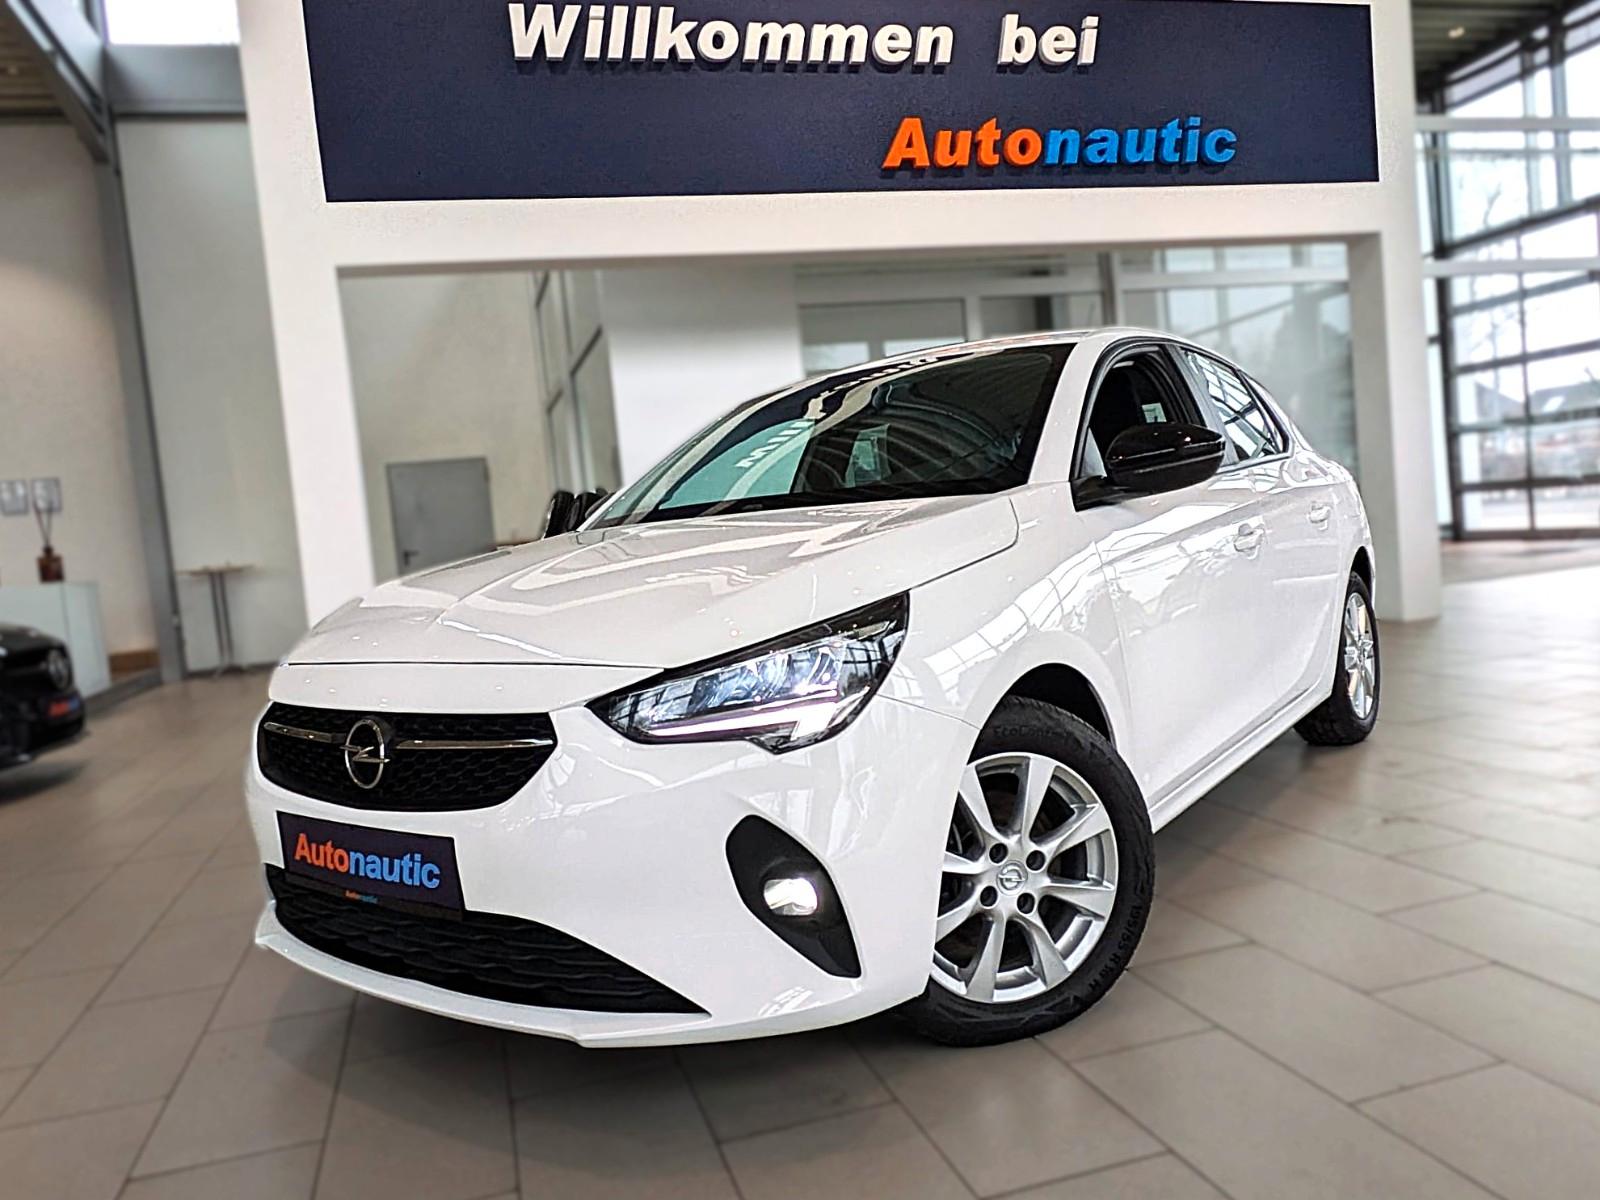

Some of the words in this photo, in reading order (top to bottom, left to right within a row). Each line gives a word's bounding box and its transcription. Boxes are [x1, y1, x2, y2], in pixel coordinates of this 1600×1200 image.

[508, 3, 954, 64] Willkommen
[998, 15, 1099, 66] bei
[882, 115, 1238, 170] Autonautic
[294, 832, 441, 889] Autonautic
